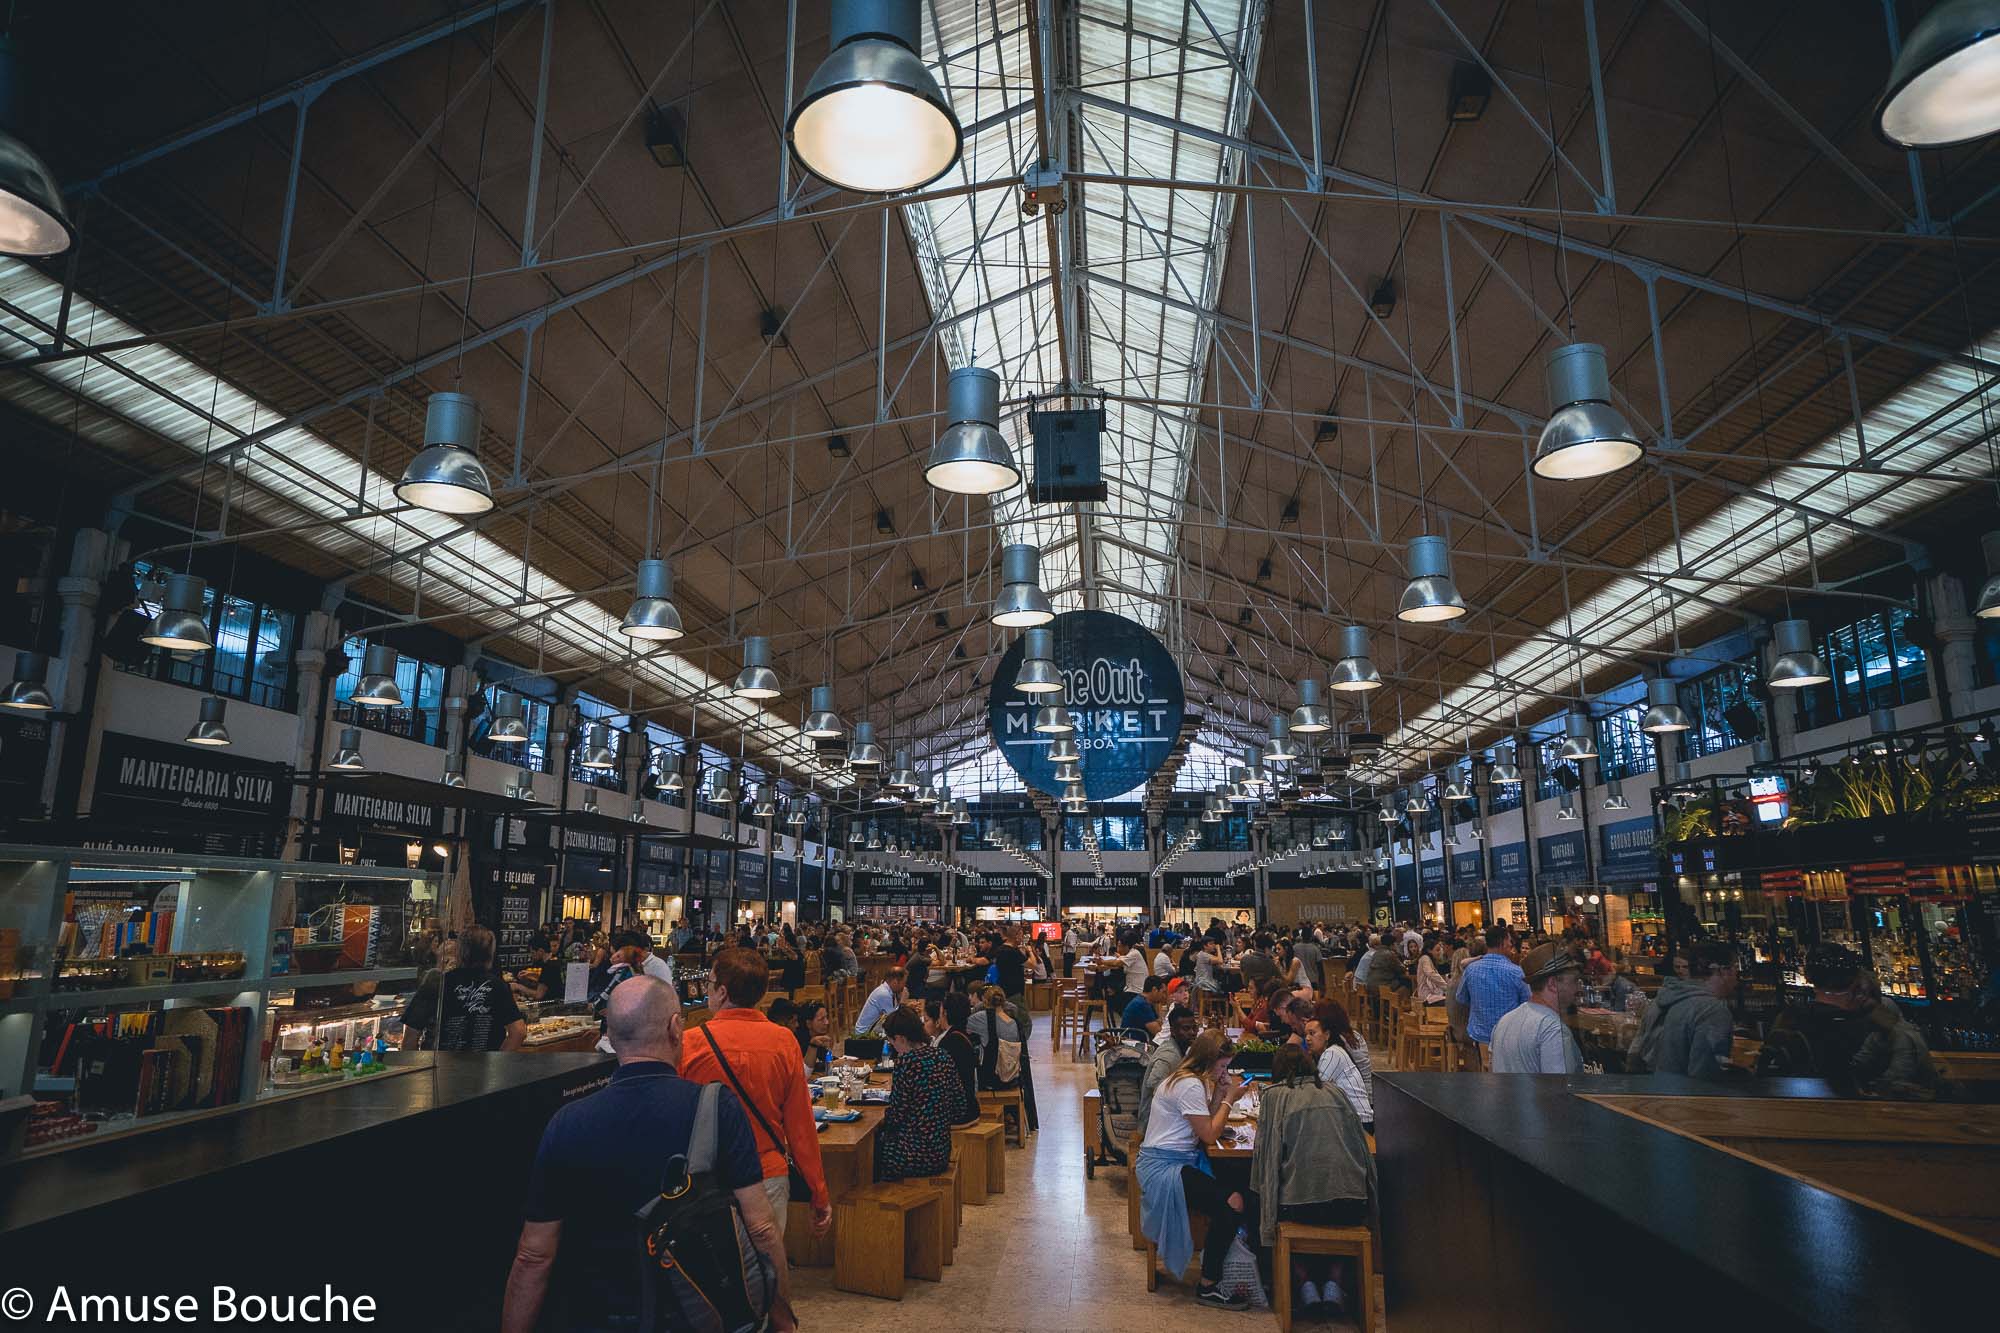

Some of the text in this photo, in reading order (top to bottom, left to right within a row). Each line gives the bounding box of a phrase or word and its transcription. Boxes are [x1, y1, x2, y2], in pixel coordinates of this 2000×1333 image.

[1006, 709, 1168, 734] MRKET
[1073, 738, 1116, 751] SBOA
[119, 756, 273, 805] MANTEIGARIA SILVA
[333, 791, 432, 827] MANTEIGARIA SILVA
[565, 831, 588, 849] COZINHA
[1610, 828, 1655, 851] GROUND BURGER
[1551, 841, 1576, 860] CONFRARIA
[870, 876, 925, 887] ALEXANDRE SILVA
[964, 877, 987, 887] MIGUEL
[1019, 877, 1038, 887] SILVA
[1072, 877, 1103, 887] HENRIQUE
[1114, 877, 1138, 887] PESSOA
[1183, 877, 1235, 887] MARLENE VIEIRA
